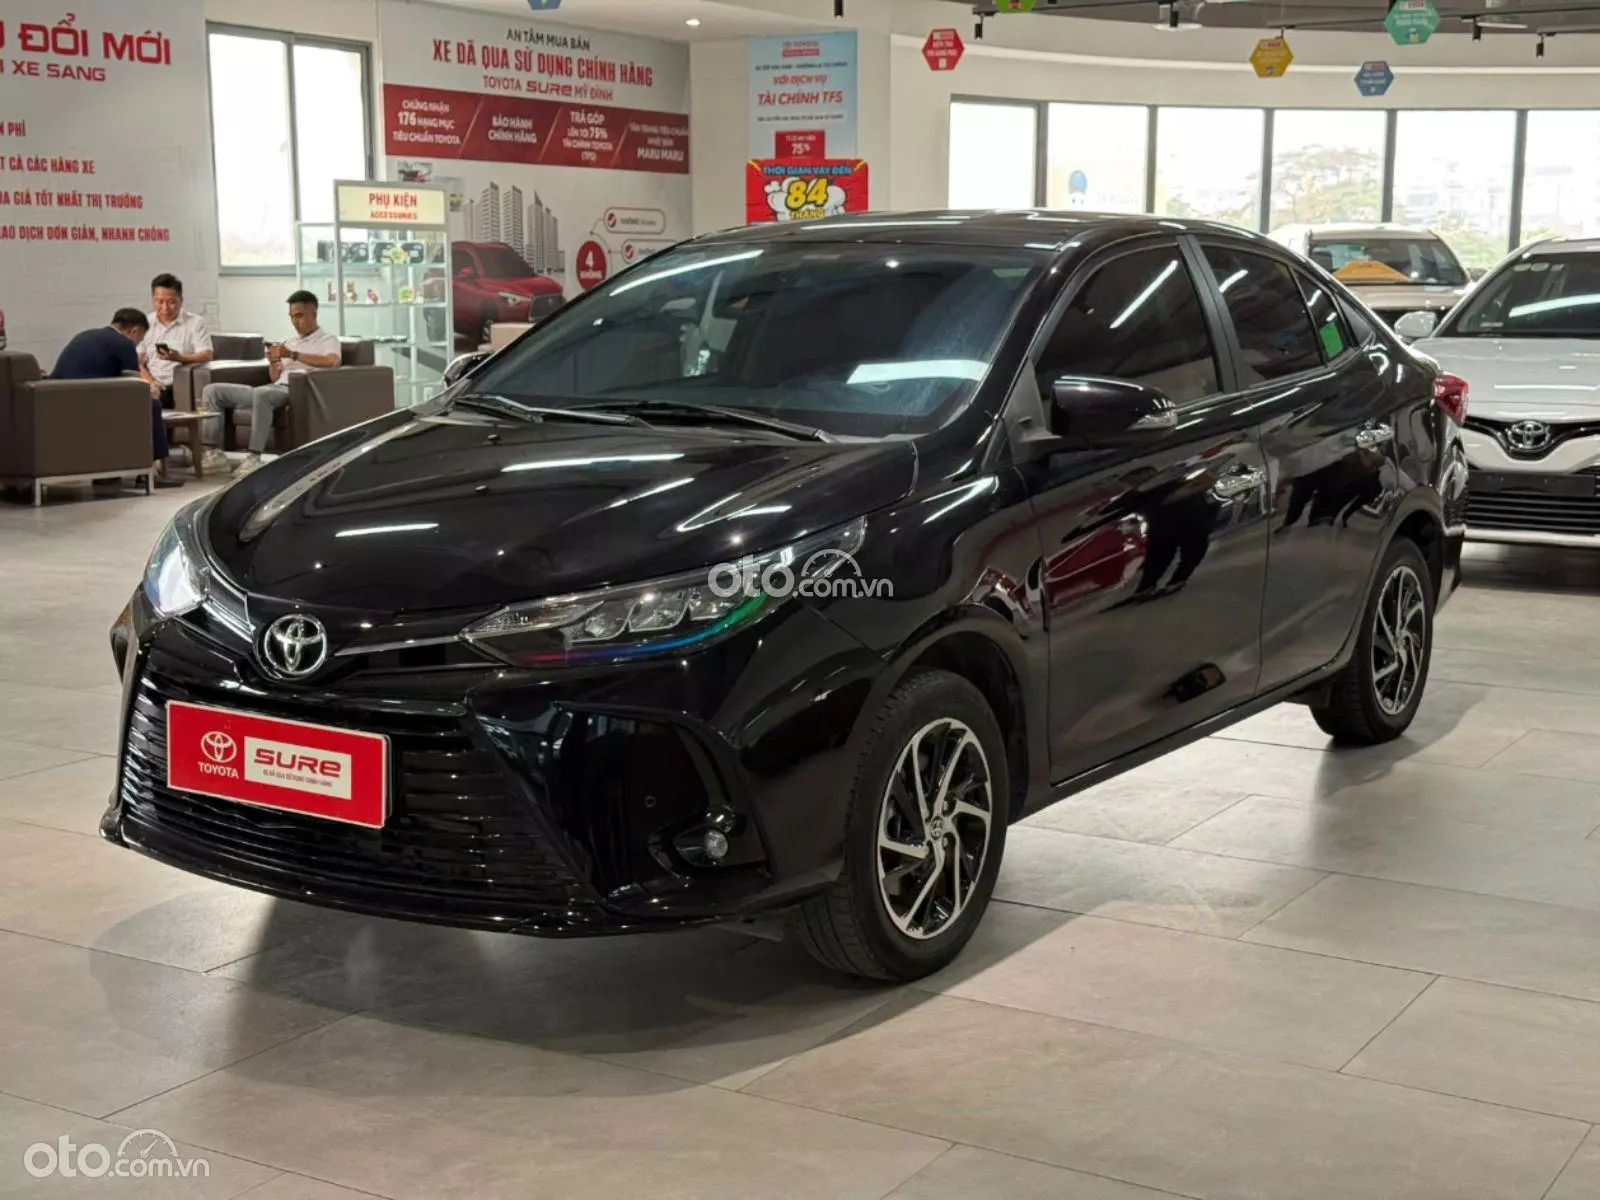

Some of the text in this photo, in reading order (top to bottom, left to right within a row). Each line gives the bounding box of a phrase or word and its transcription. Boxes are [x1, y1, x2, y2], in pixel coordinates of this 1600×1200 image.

[18, 12, 89, 57] ĐỔI
[102, 29, 171, 65] MỚI
[507, 29, 522, 42] AN
[546, 34, 568, 48] MUA
[432, 38, 451, 62] XE
[481, 45, 510, 71] QUA
[537, 52, 573, 78] DỤNG
[577, 54, 616, 82] CHÍNH
[12, 59, 40, 77] XE
[46, 63, 106, 82] SANG
[482, 75, 522, 92] TOYOTA
[822, 91, 843, 104] TFS
[398, 111, 417, 126] 176
[82, 160, 95, 174] XE
[369, 191, 417, 209] PHỤ KIỆN
[785, 176, 828, 210] 84
[102, 227, 135, 242] NHANH
[585, 250, 594, 271] 4
[197, 761, 239, 780] TOYOTA
